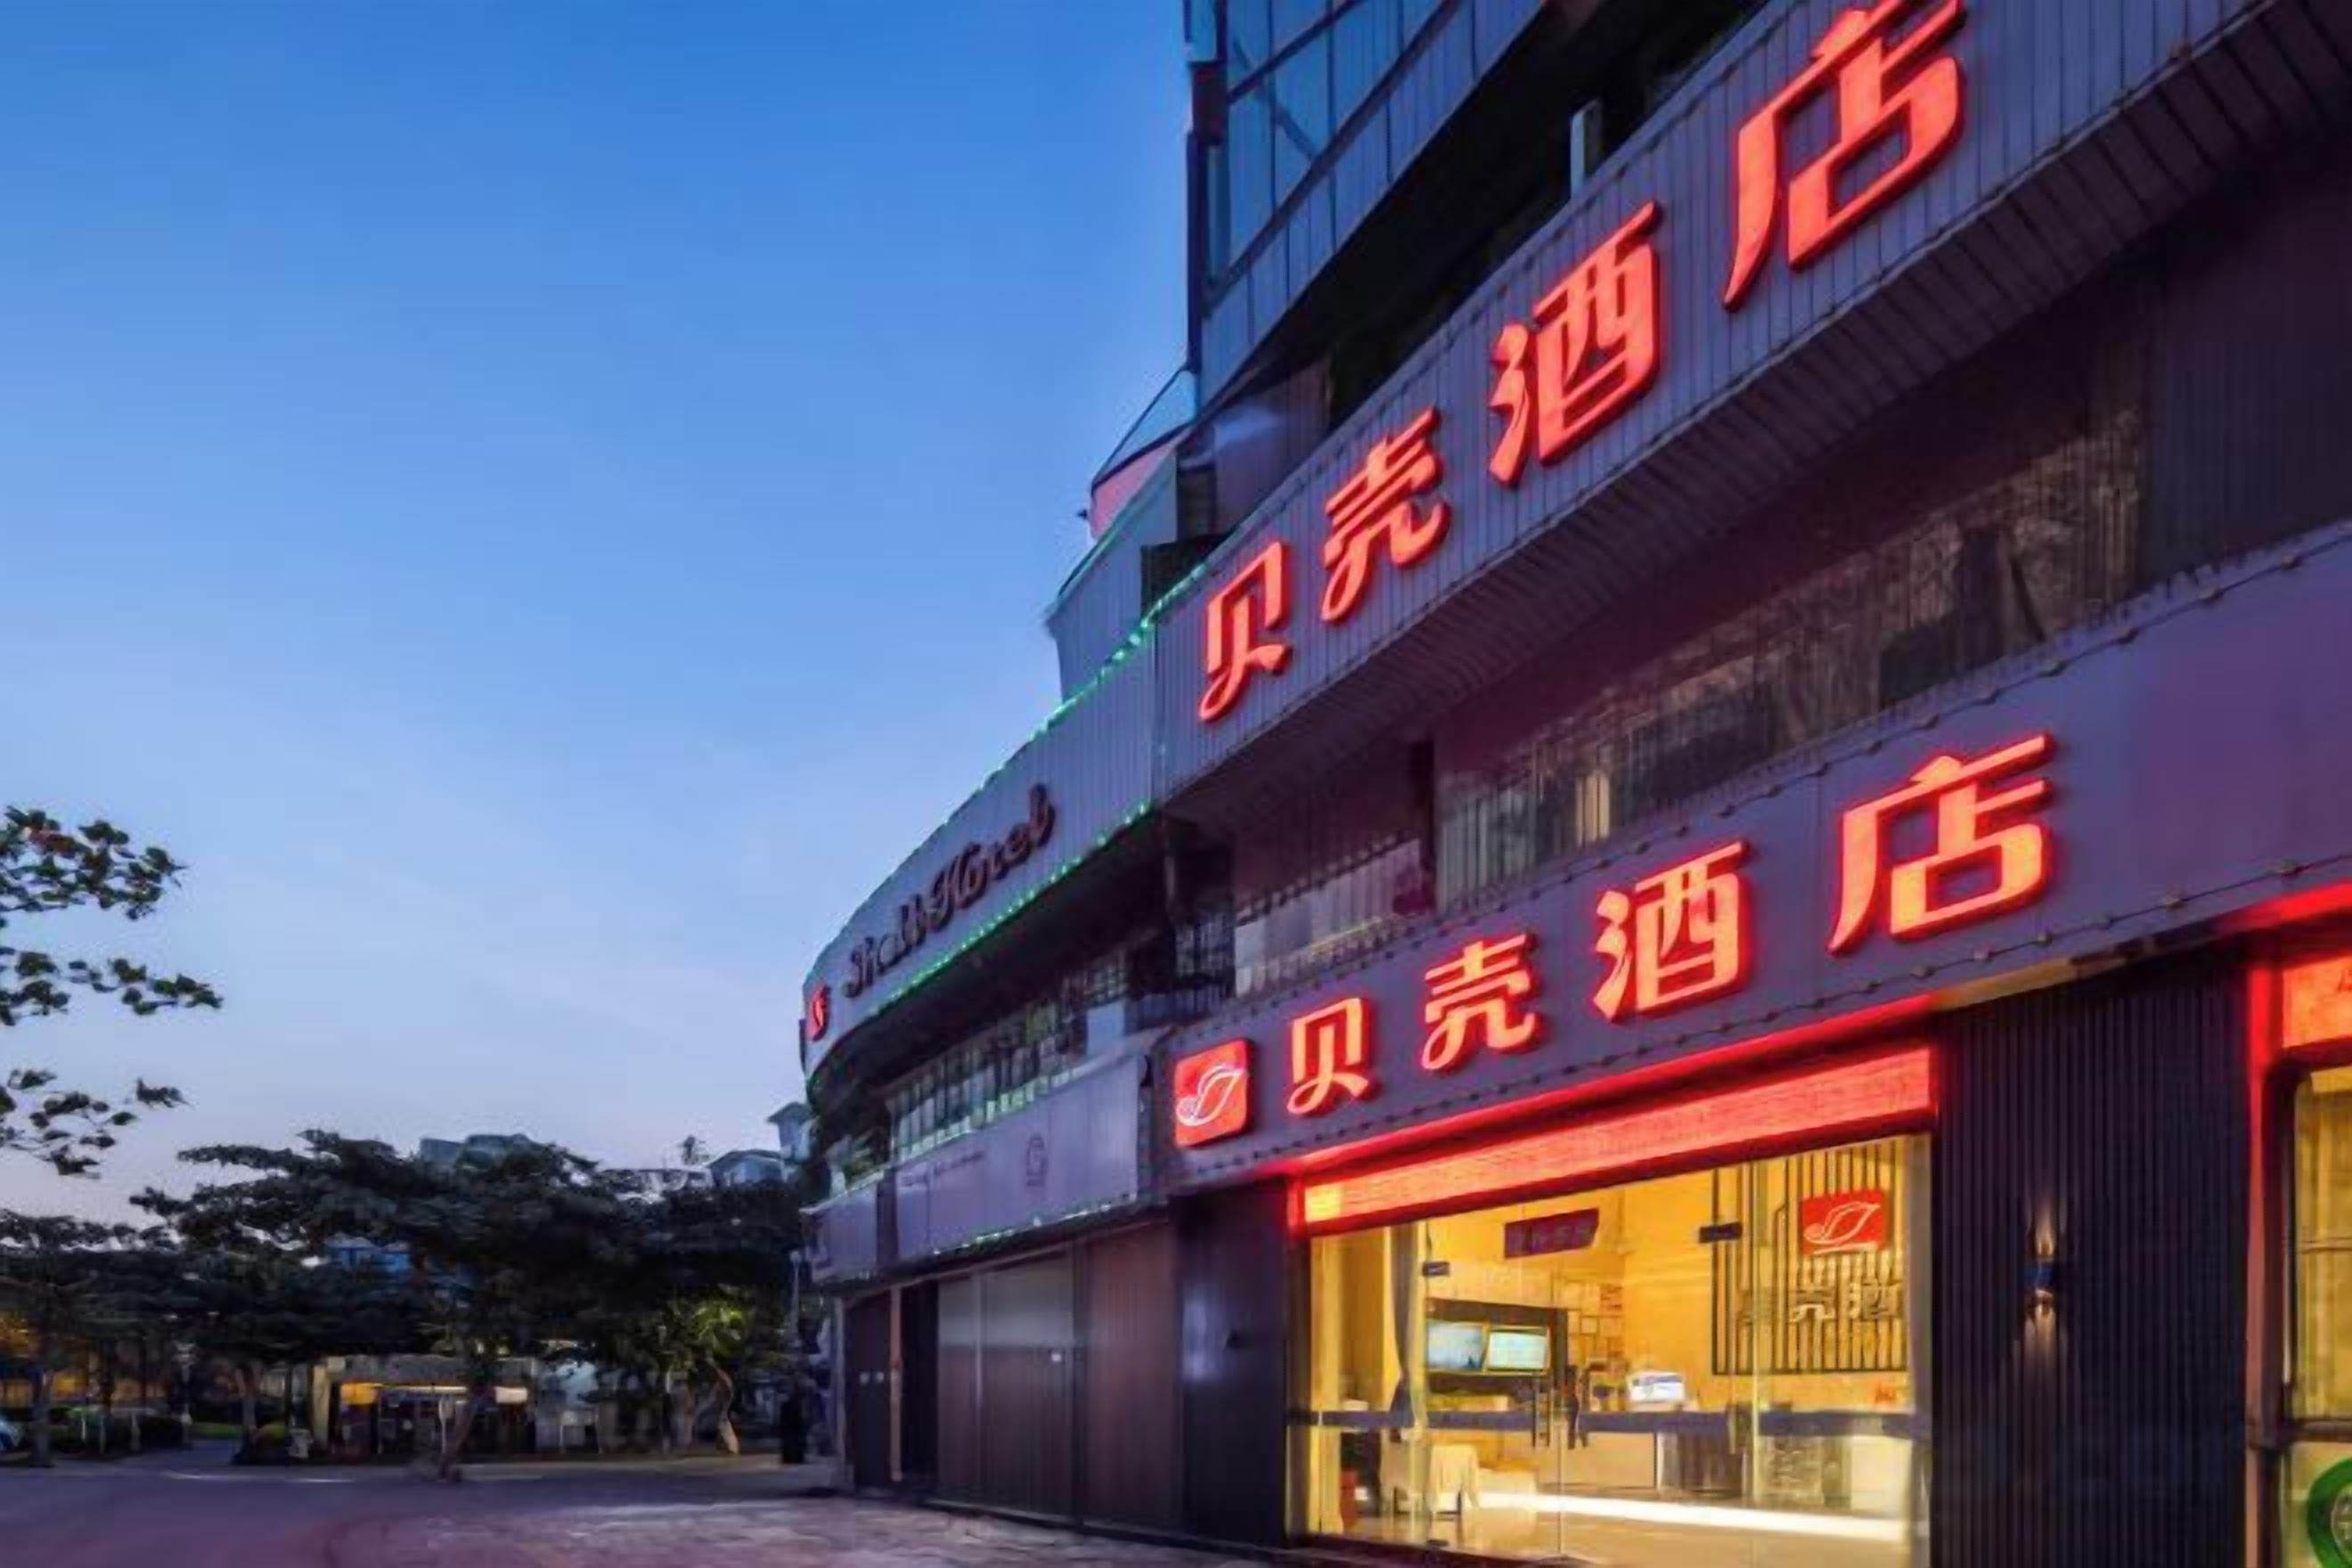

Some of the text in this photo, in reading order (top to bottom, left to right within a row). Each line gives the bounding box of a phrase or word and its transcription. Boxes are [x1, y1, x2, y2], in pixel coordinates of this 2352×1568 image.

[1197, 0, 1965, 723] 贝壳酒店
[1286, 731, 2051, 1115] 贝壳酒店
